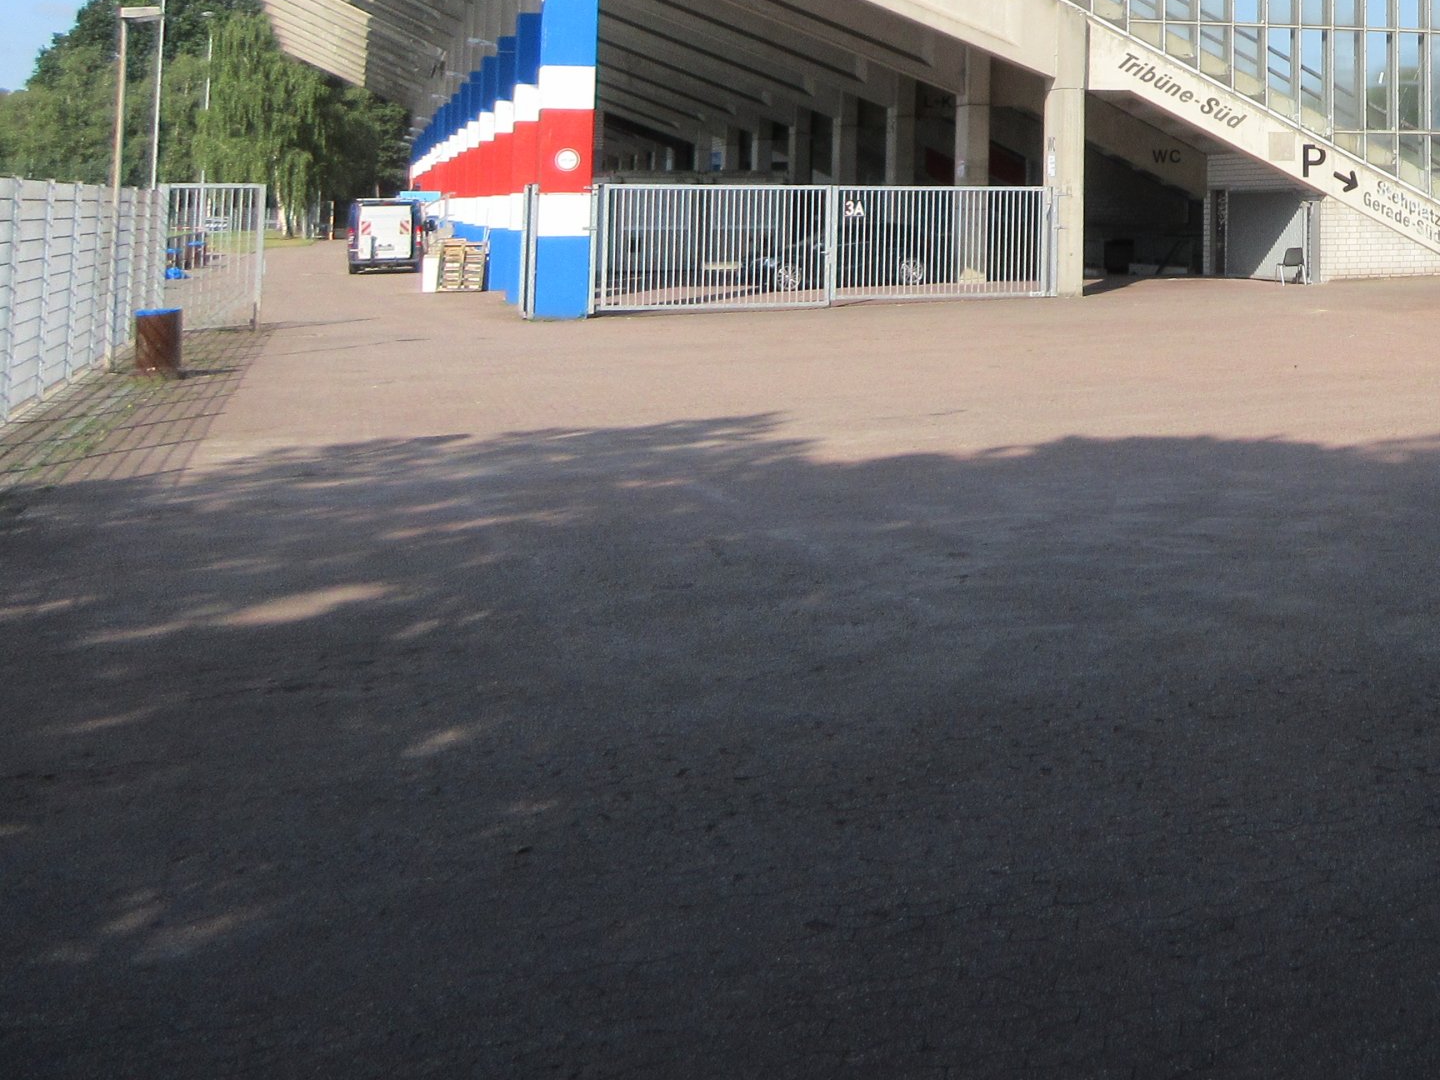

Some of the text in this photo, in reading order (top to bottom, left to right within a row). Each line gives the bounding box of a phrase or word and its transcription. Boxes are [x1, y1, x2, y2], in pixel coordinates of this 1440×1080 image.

[1118, 52, 1248, 129] Tribüne-Süd
[1152, 149, 1181, 163] WC
[1302, 144, 1326, 178] P
[845, 200, 865, 216] 3A
[1363, 191, 1440, 245] Gerade-Süd
